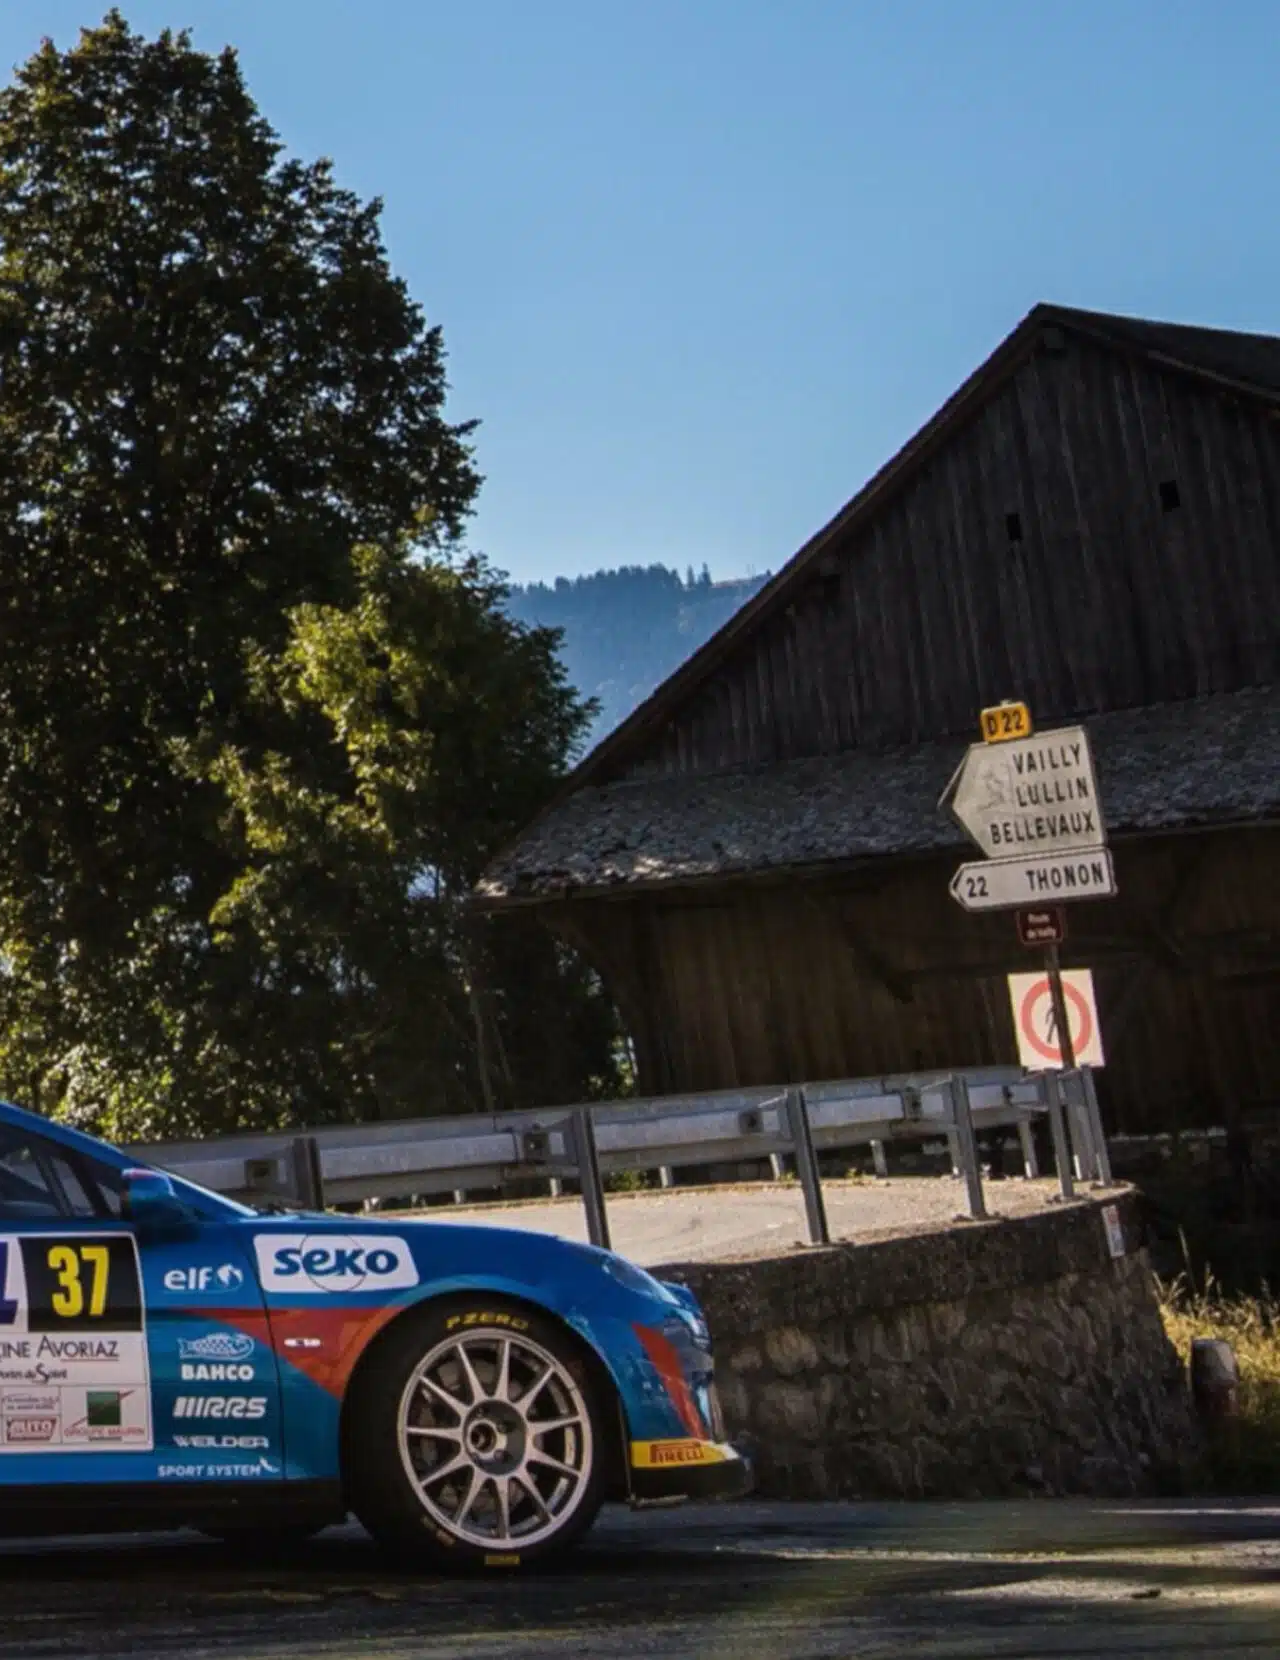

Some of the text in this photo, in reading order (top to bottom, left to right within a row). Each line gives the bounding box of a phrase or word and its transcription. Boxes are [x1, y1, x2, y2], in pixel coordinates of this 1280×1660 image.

[987, 709, 1025, 737] D 22
[1012, 744, 1081, 776] VAILLY
[1017, 777, 1090, 808] LULLIN
[990, 812, 1096, 846] BELLEVAUX
[966, 862, 1105, 899] 22 THONON
[46, 1245, 110, 1318] 37
[163, 1265, 213, 1292] elf
[181, 1364, 255, 1381] BAHCO
[649, 1442, 705, 1464] PIRELLI
[157, 1461, 262, 1478] SPORT SYSTEM
